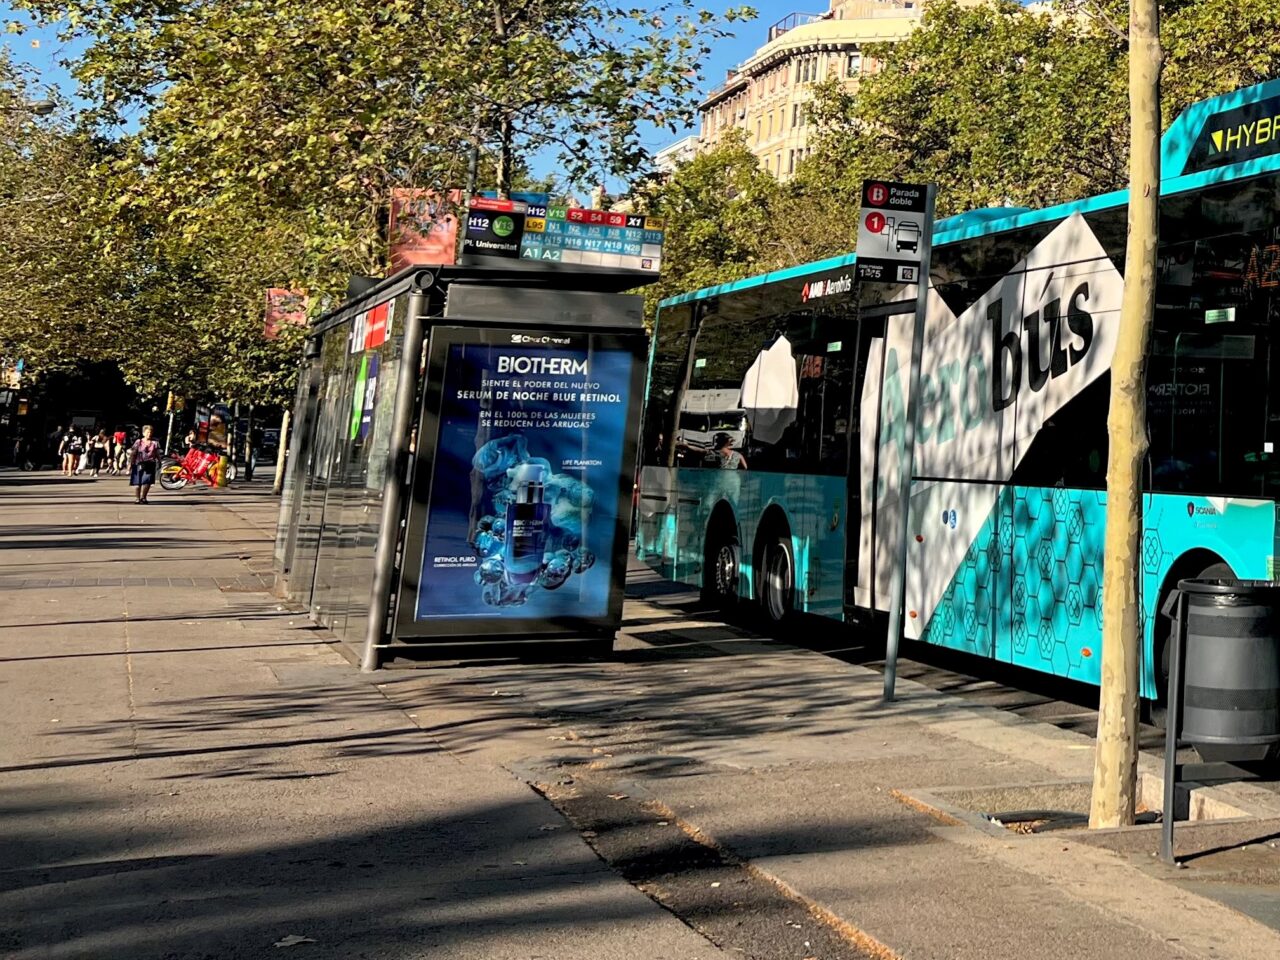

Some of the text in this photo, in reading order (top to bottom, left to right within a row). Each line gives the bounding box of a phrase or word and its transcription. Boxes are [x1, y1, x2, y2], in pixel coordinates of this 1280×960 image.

[872, 188, 884, 201] B
[890, 187, 920, 198] Parada
[890, 196, 912, 206] doble
[528, 207, 546, 216] H12
[548, 209, 565, 218] V13
[571, 212, 583, 220] 52
[590, 214, 602, 222] 54
[610, 216, 622, 224] 59
[628, 217, 641, 226] X1
[871, 216, 878, 229] 1
[468, 217, 513, 229] H12 V13
[526, 220, 543, 229] L95
[626, 230, 641, 238] N12
[645, 232, 661, 240] N13
[476, 240, 517, 250] Universitat
[604, 241, 622, 249] N18
[522, 248, 560, 260] A1 A2
[1242, 244, 1280, 288] A2
[825, 274, 851, 295] Aerobús
[497, 356, 588, 375] BIOTHERM
[879, 270, 1094, 460] Aerobús
[512, 380, 521, 388] EL
[457, 390, 621, 402] SERUM DE NOCHE BLUE RETINOL
[561, 412, 596, 420] MUJERES
